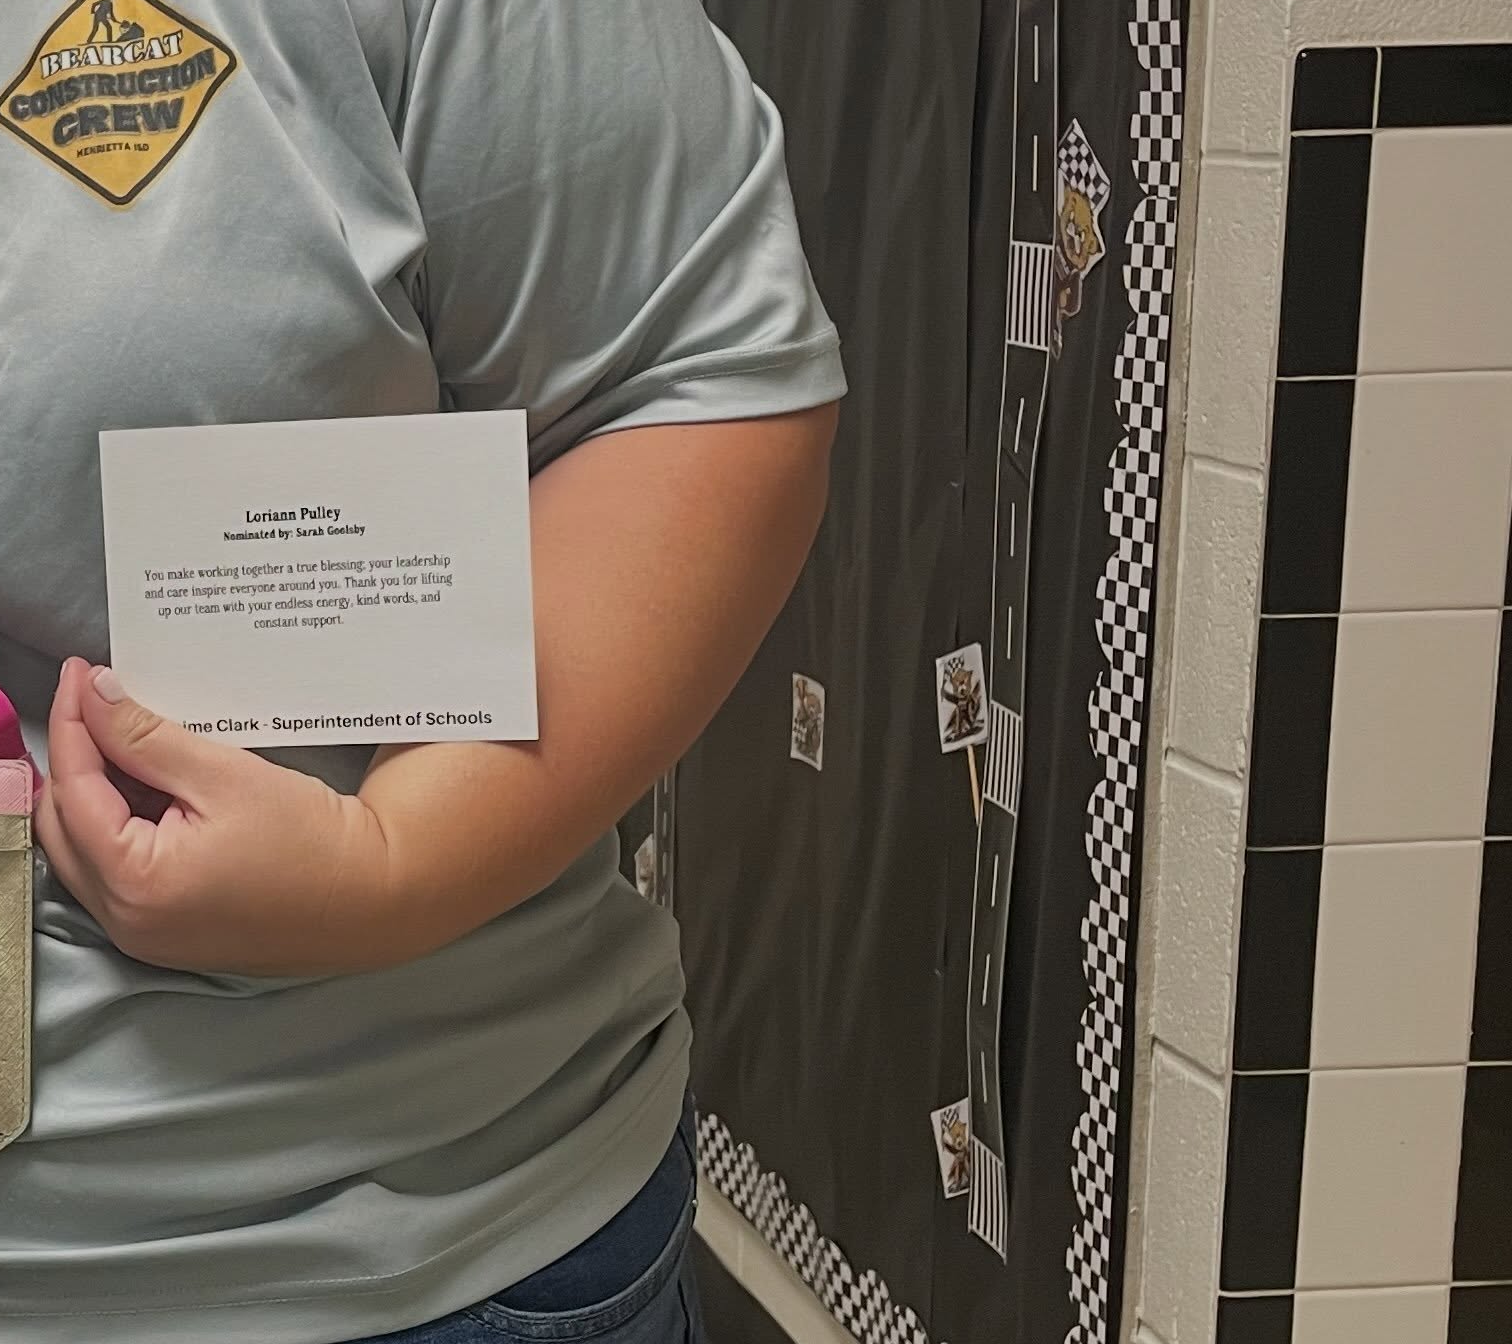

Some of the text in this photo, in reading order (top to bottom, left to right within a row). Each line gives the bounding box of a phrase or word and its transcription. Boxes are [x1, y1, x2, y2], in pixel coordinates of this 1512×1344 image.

[40, 29, 184, 80] BEARCAT
[9, 47, 217, 120] CONSTRUCTION
[52, 97, 185, 146] CREW
[246, 506, 341, 523] Loriann Pulley
[223, 524, 366, 541] Nominated by: Sarah Goolsby
[144, 569, 164, 581] You
[167, 568, 195, 580] make
[197, 565, 239, 579] working
[241, 563, 284, 578] together
[287, 564, 294, 574] a
[296, 563, 318, 573] true
[368, 559, 393, 573] your
[396, 554, 451, 569] leadership
[144, 587, 164, 599] and
[166, 588, 189, 598] care
[191, 584, 227, 599] inspire
[229, 582, 276, 597] everyone
[278, 578, 316, 592] around
[344, 575, 377, 589] Thank
[380, 576, 400, 590] you
[402, 574, 418, 586] for
[421, 572, 453, 586] lifting
[158, 607, 172, 619] up
[174, 605, 191, 615] our
[194, 604, 220, 615] team
[223, 600, 245, 613] with
[247, 601, 273, 614] your
[274, 597, 314, 610] endless
[356, 593, 381, 606] kind
[420, 590, 441, 603] and
[254, 615, 298, 629] constant
[182, 719, 213, 734] ime
[216, 718, 260, 733] Clark
[271, 712, 402, 732] Superintendent
[405, 711, 421, 726] of
[425, 710, 492, 726] Schools
